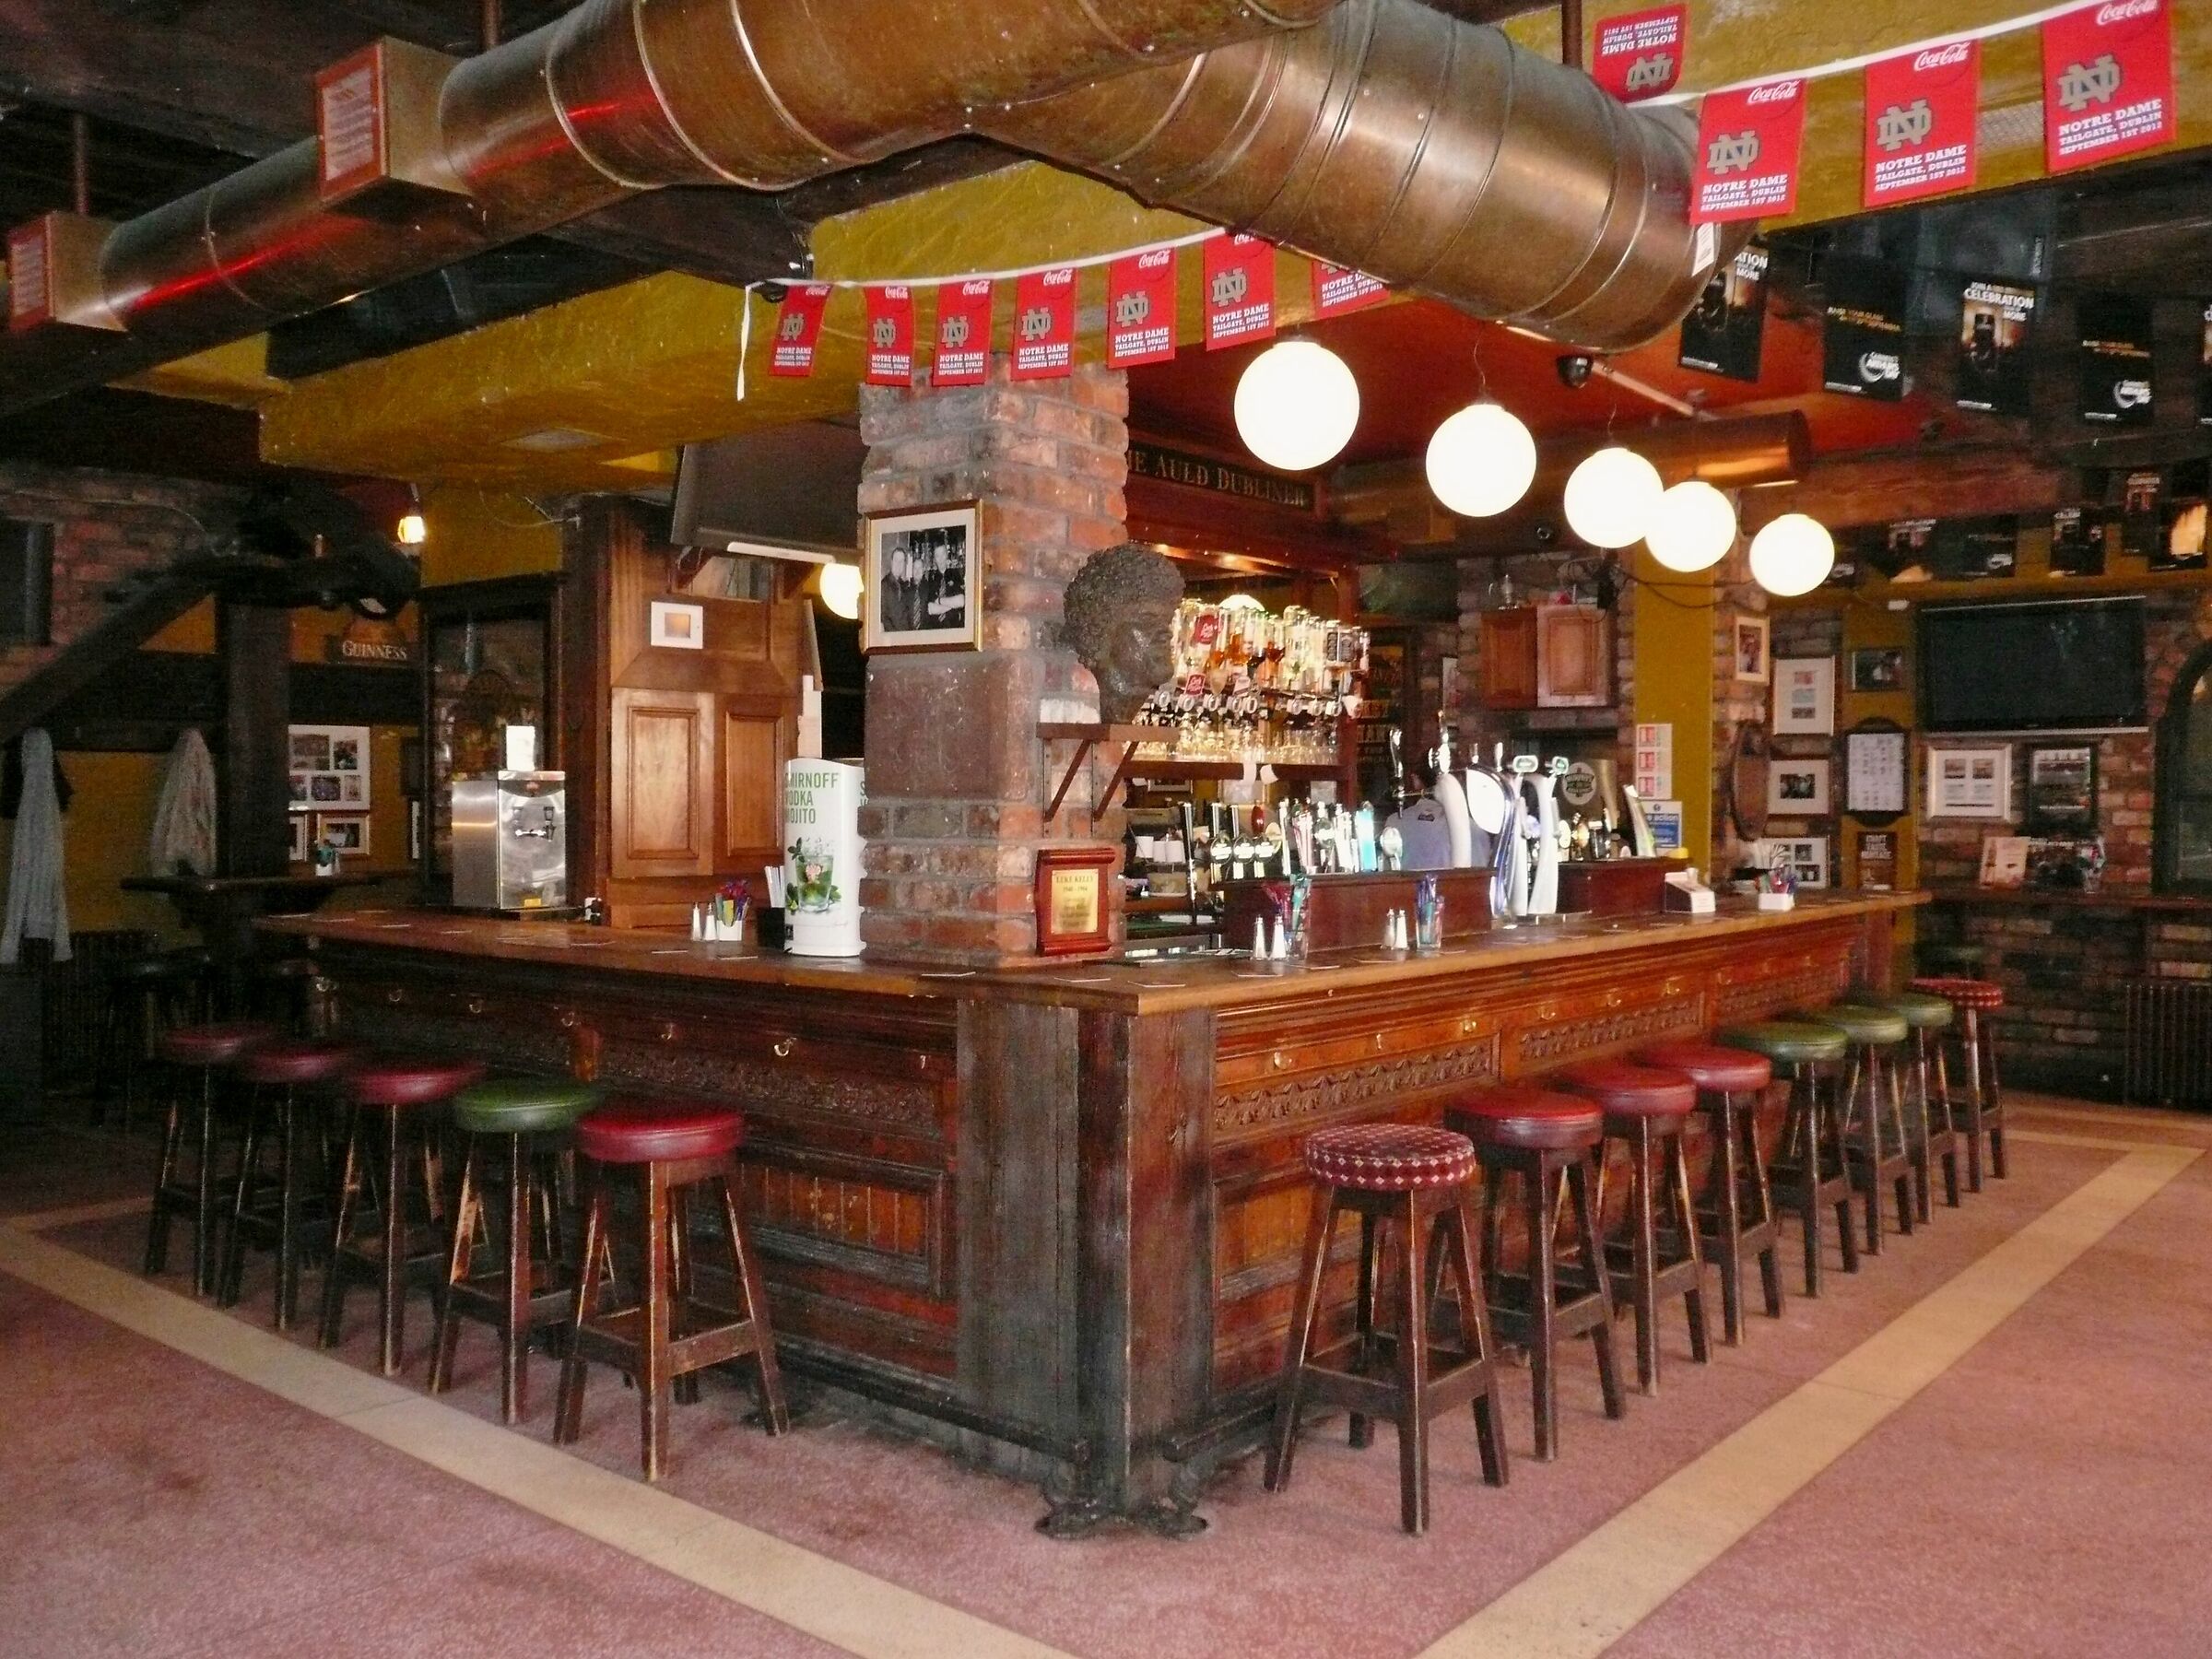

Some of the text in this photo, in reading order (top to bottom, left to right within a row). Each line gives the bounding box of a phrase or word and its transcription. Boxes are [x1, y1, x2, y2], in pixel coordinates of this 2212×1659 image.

[1602, 32, 1677, 56] NOTRE DAME
[2059, 98, 2162, 135] NOTRE DAME
[2119, 112, 2161, 129] DUBLIN
[1876, 145, 1967, 173] NOTRE DAME
[1928, 156, 1966, 171] DUBLIN
[1703, 174, 1788, 194] NOTRE DAME
[1751, 184, 1786, 196] DUBLIN
[1736, 267, 1759, 281] MORE
[1322, 275, 1354, 292] NOTRE
[1963, 288, 2035, 310] CELEBRATION
[1213, 303, 1269, 324] NOTRE DAME
[2003, 311, 2027, 322] MORE
[1115, 327, 1169, 343] NOTRE DAME
[939, 352, 984, 362] NOTRE DAME
[1019, 343, 1068, 356] NOTRE DAME
[892, 355, 910, 363] DAME
[1155, 454, 1209, 486] AULD
[1217, 467, 1304, 506] DUBLINER
[343, 641, 406, 660] GUINNESS
[785, 791, 814, 806] ODKA
[786, 808, 816, 824] OJITO
